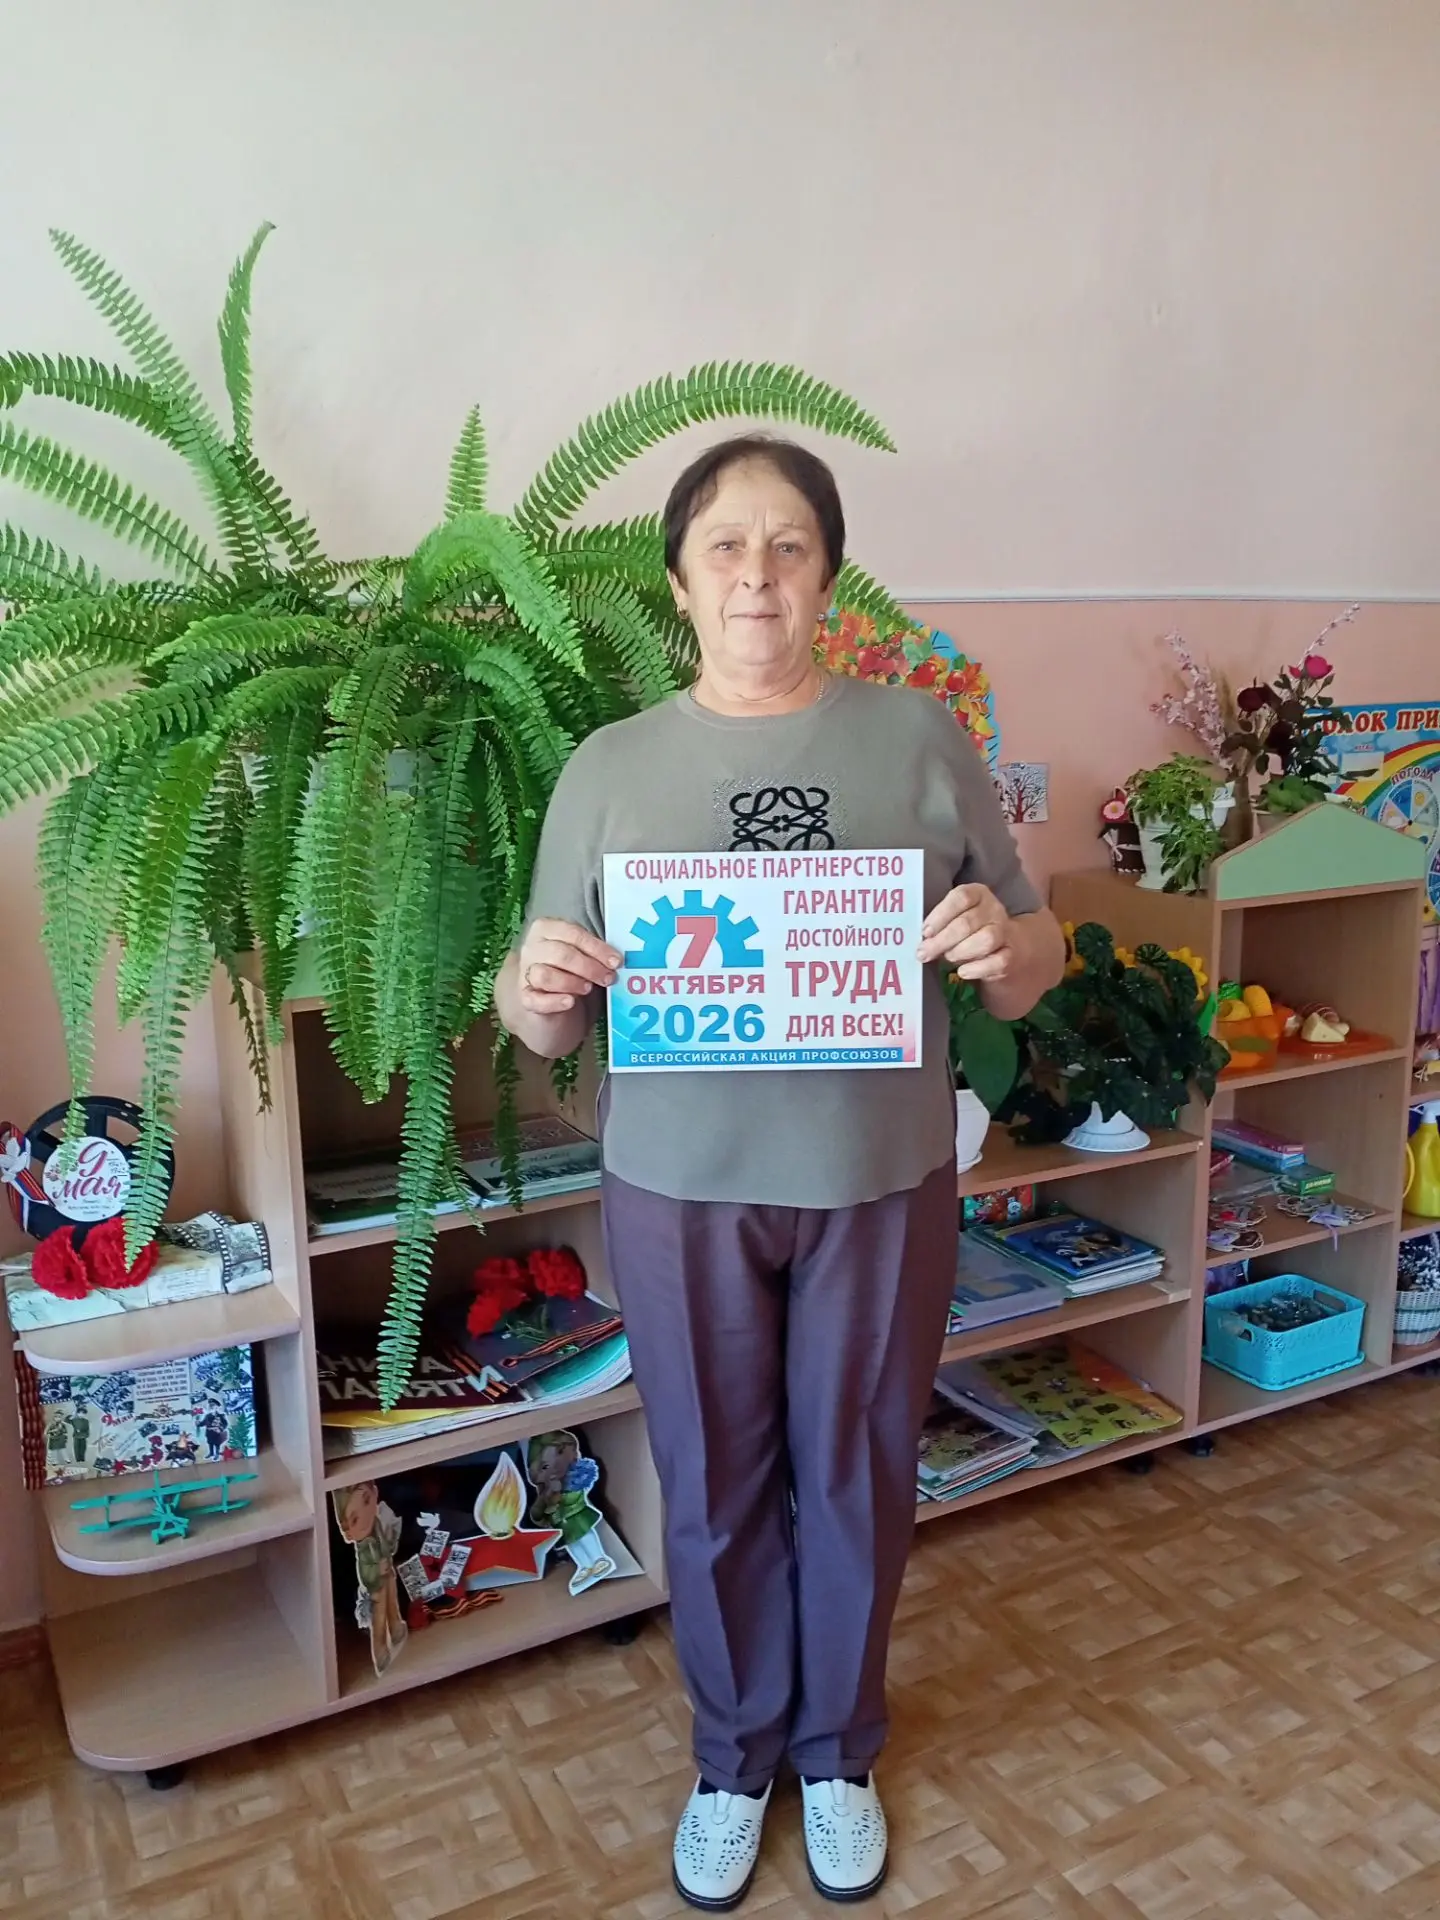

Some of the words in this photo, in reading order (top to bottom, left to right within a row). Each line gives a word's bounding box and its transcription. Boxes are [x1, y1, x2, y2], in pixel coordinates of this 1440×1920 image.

[1396, 708, 1440, 732] ПРИ
[1391, 767, 1434, 786] ПОГОДА
[625, 858, 757, 883] СОЦИАЛЬНОЕ
[762, 855, 903, 879] ПАРТНЕРСТВО
[783, 889, 904, 914] ГАРАНТИЯ
[676, 916, 717, 968] 7
[785, 925, 904, 951] ДОСТОЙНОГО
[627, 974, 765, 995] ОКТЯБРЯ
[785, 960, 902, 1004] ТРУДА
[629, 1003, 765, 1043] 2026
[786, 1015, 834, 1042] ДЛЯ
[842, 1013, 904, 1037] ВСЕХ!
[630, 1051, 746, 1064] ВСЕРОССИЙСКАЯ
[751, 1050, 797, 1063] АКЦИЯ
[801, 1049, 899, 1062] ПРОФСОЮЗОВ
[78, 1141, 108, 1177] 9
[52, 1175, 121, 1200] мая
